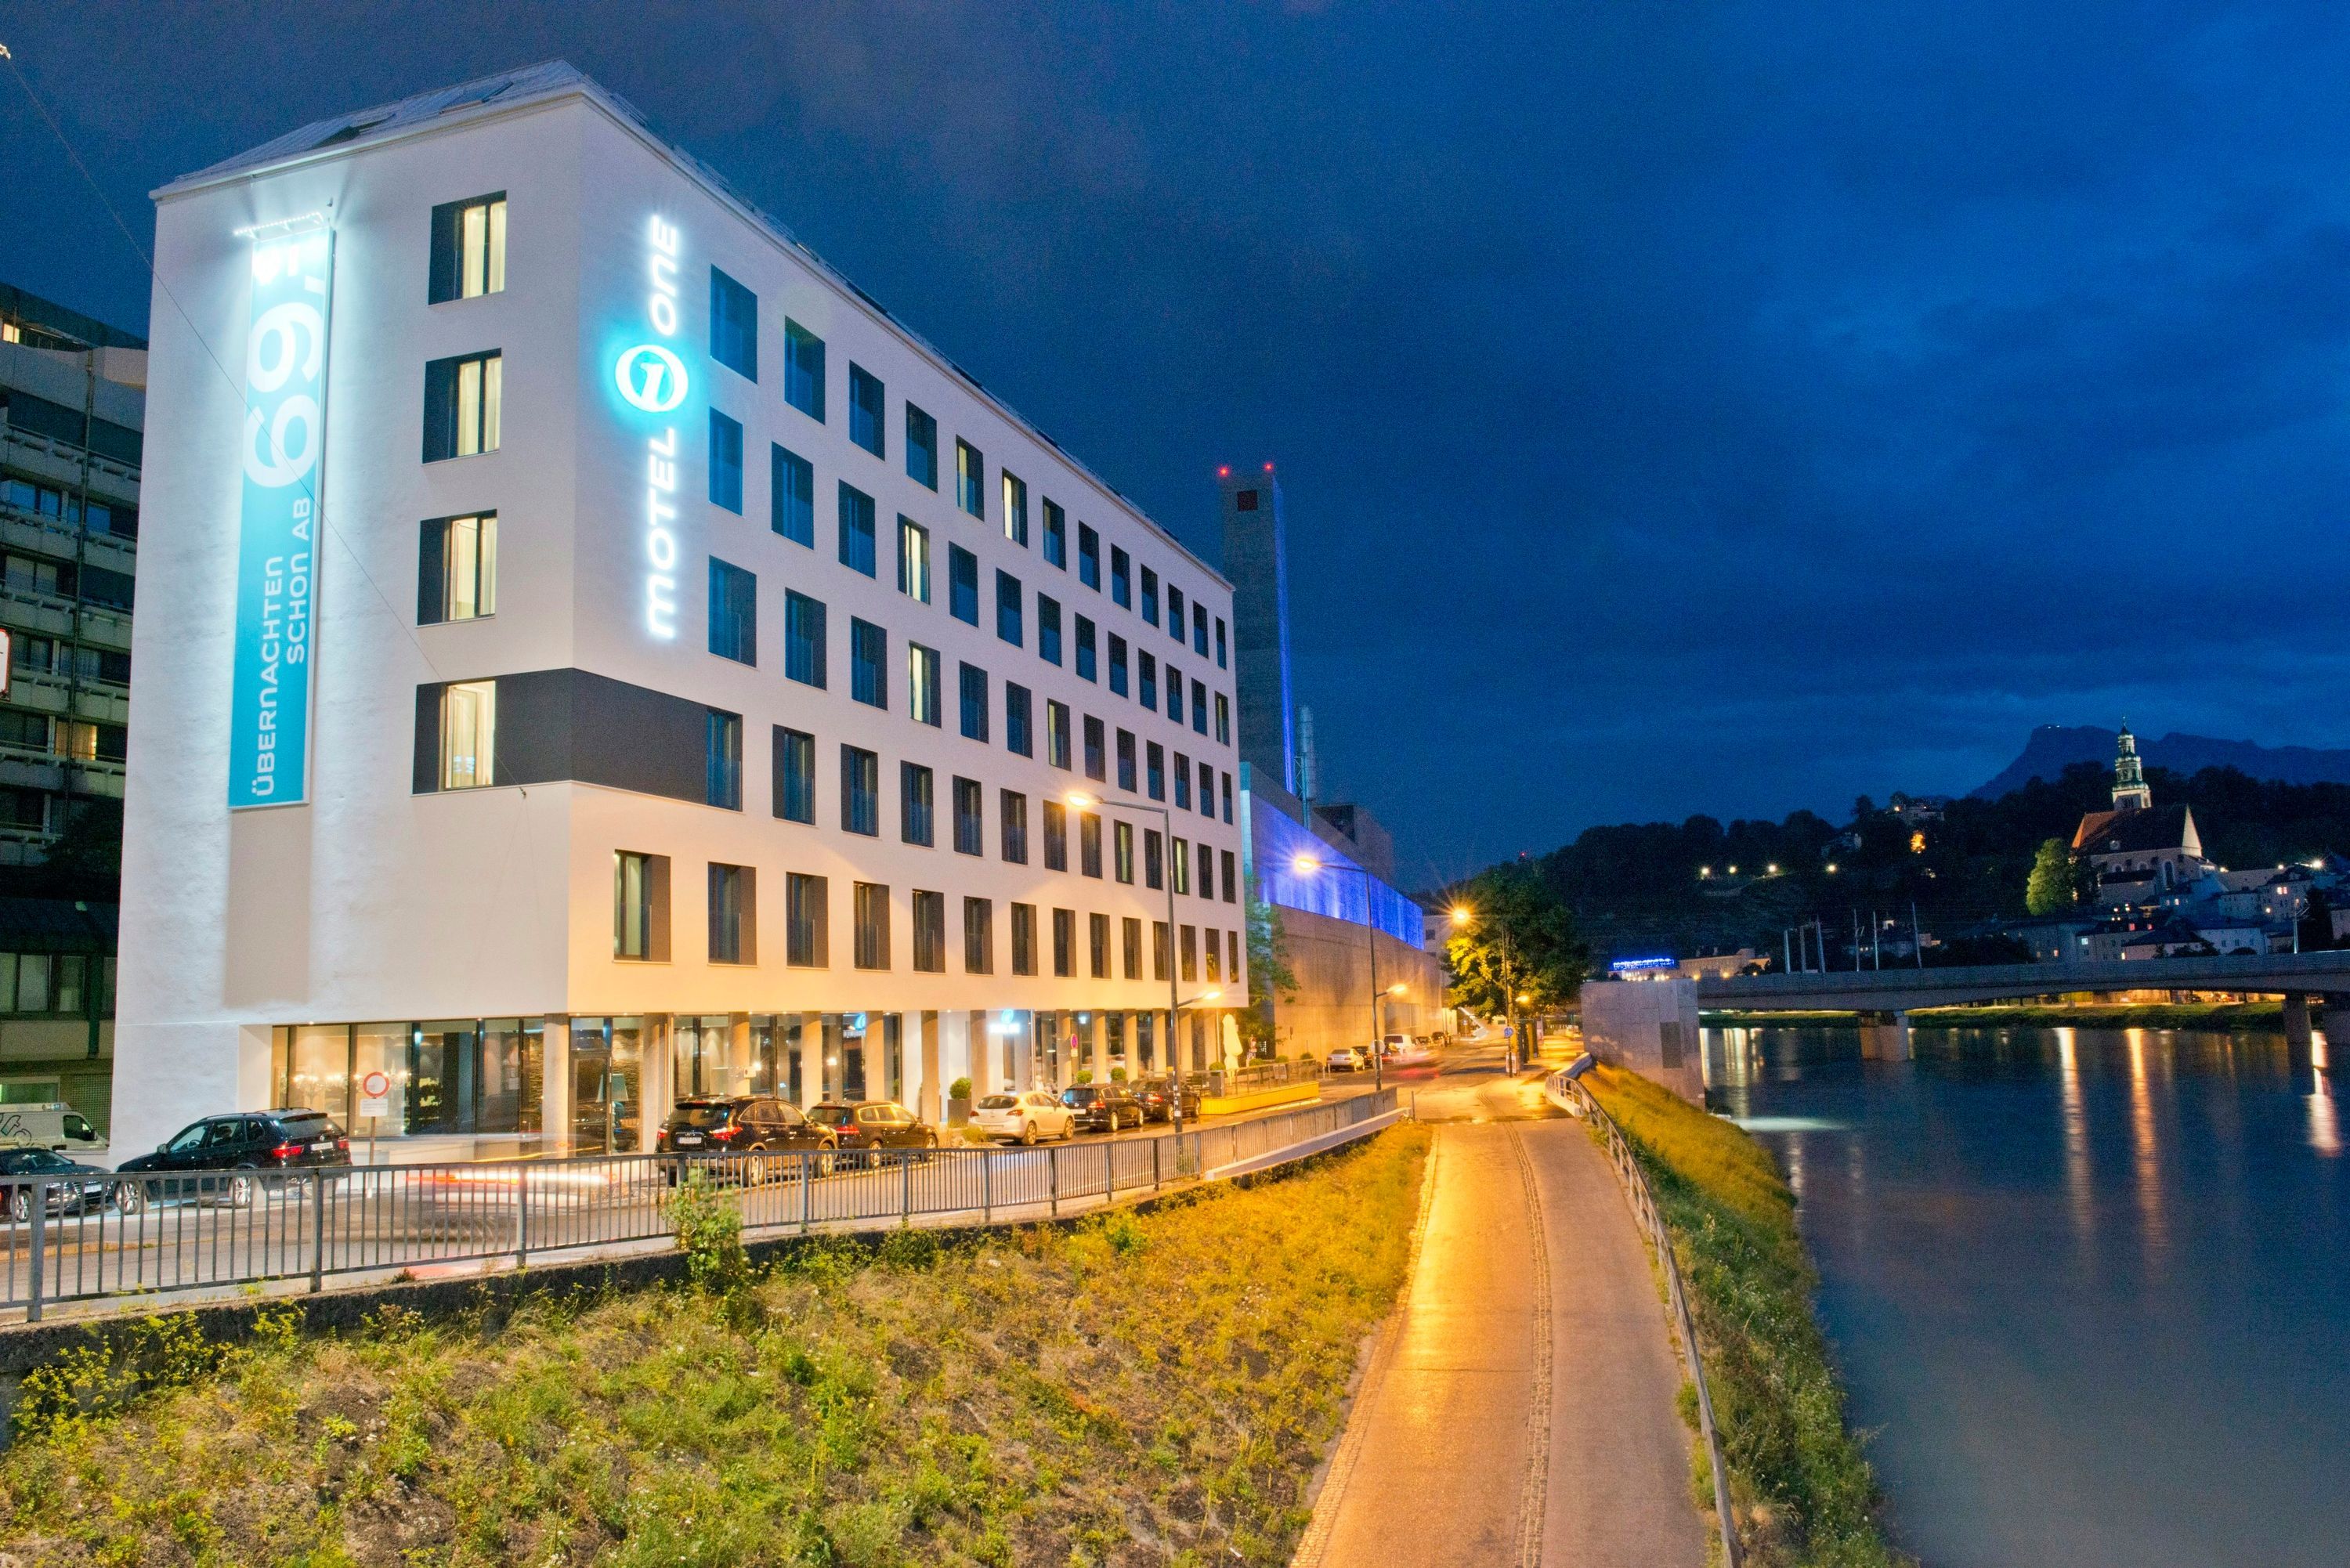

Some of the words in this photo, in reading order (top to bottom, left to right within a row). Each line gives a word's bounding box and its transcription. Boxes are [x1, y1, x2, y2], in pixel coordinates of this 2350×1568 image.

[649, 215, 678, 337] ONE
[291, 497, 310, 541] AB
[647, 428, 676, 640] MOTEL
[286, 552, 309, 665] SCHON
[251, 555, 284, 797] ÜBERNACHTEN
